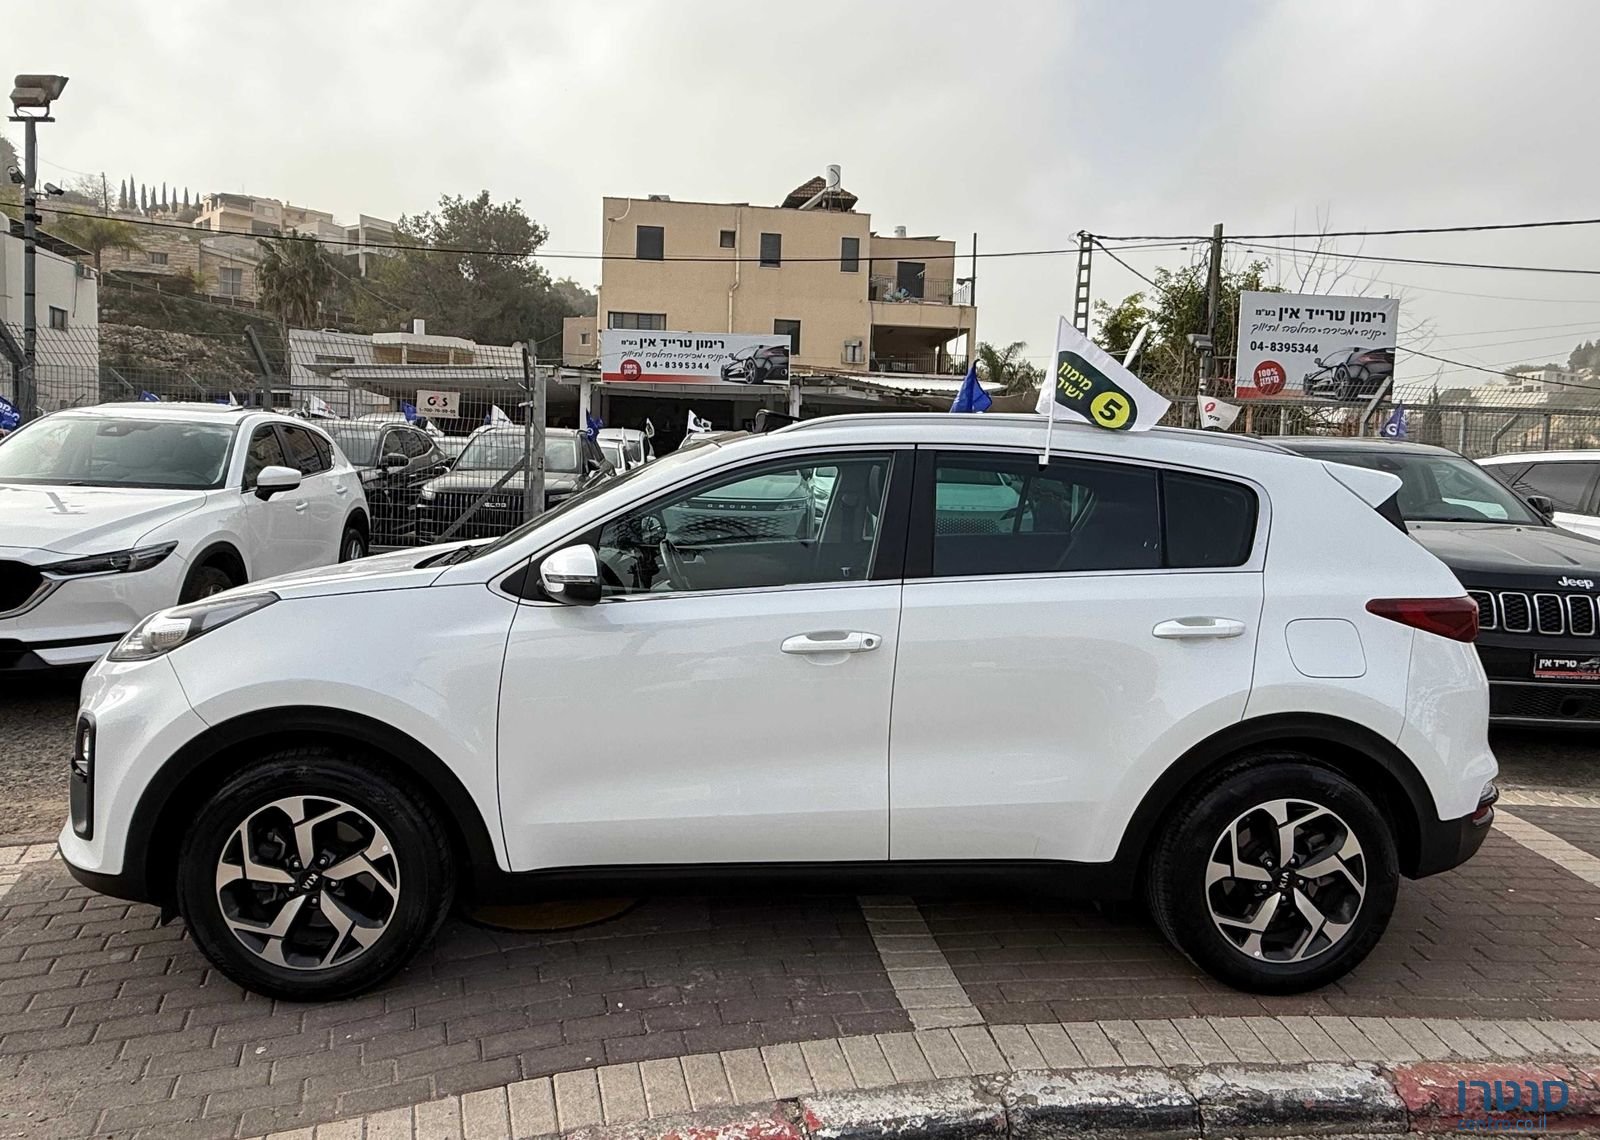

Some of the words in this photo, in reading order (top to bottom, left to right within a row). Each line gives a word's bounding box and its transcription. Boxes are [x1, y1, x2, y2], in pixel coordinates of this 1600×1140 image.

[1278, 307, 1300, 321] אין
[1305, 309, 1346, 322] טרייד
[1350, 311, 1386, 324] רימון
[1251, 323, 1280, 336] ותיווך
[1281, 322, 1317, 334] החלפה
[1322, 327, 1354, 337] מכירה
[1360, 330, 1382, 341] קניה
[639, 337, 657, 349] אין
[660, 338, 692, 349] טרייד
[696, 339, 725, 350] רימון
[1250, 341, 1319, 354] 04-8395344
[646, 349, 673, 359] החלפה
[707, 354, 724, 363] קניה
[645, 361, 710, 370] 04-8395344
[1058, 362, 1093, 391] מימון
[1257, 367, 1278, 378] 100%
[1057, 377, 1084, 400] ישיר
[1098, 399, 1123, 421] 5
[1558, 576, 1594, 589] Jeep
[1539, 659, 1552, 669] אין
[1553, 659, 1577, 668] טרייד
[302, 873, 318, 889] KIA
[1278, 872, 1290, 888] KIA
